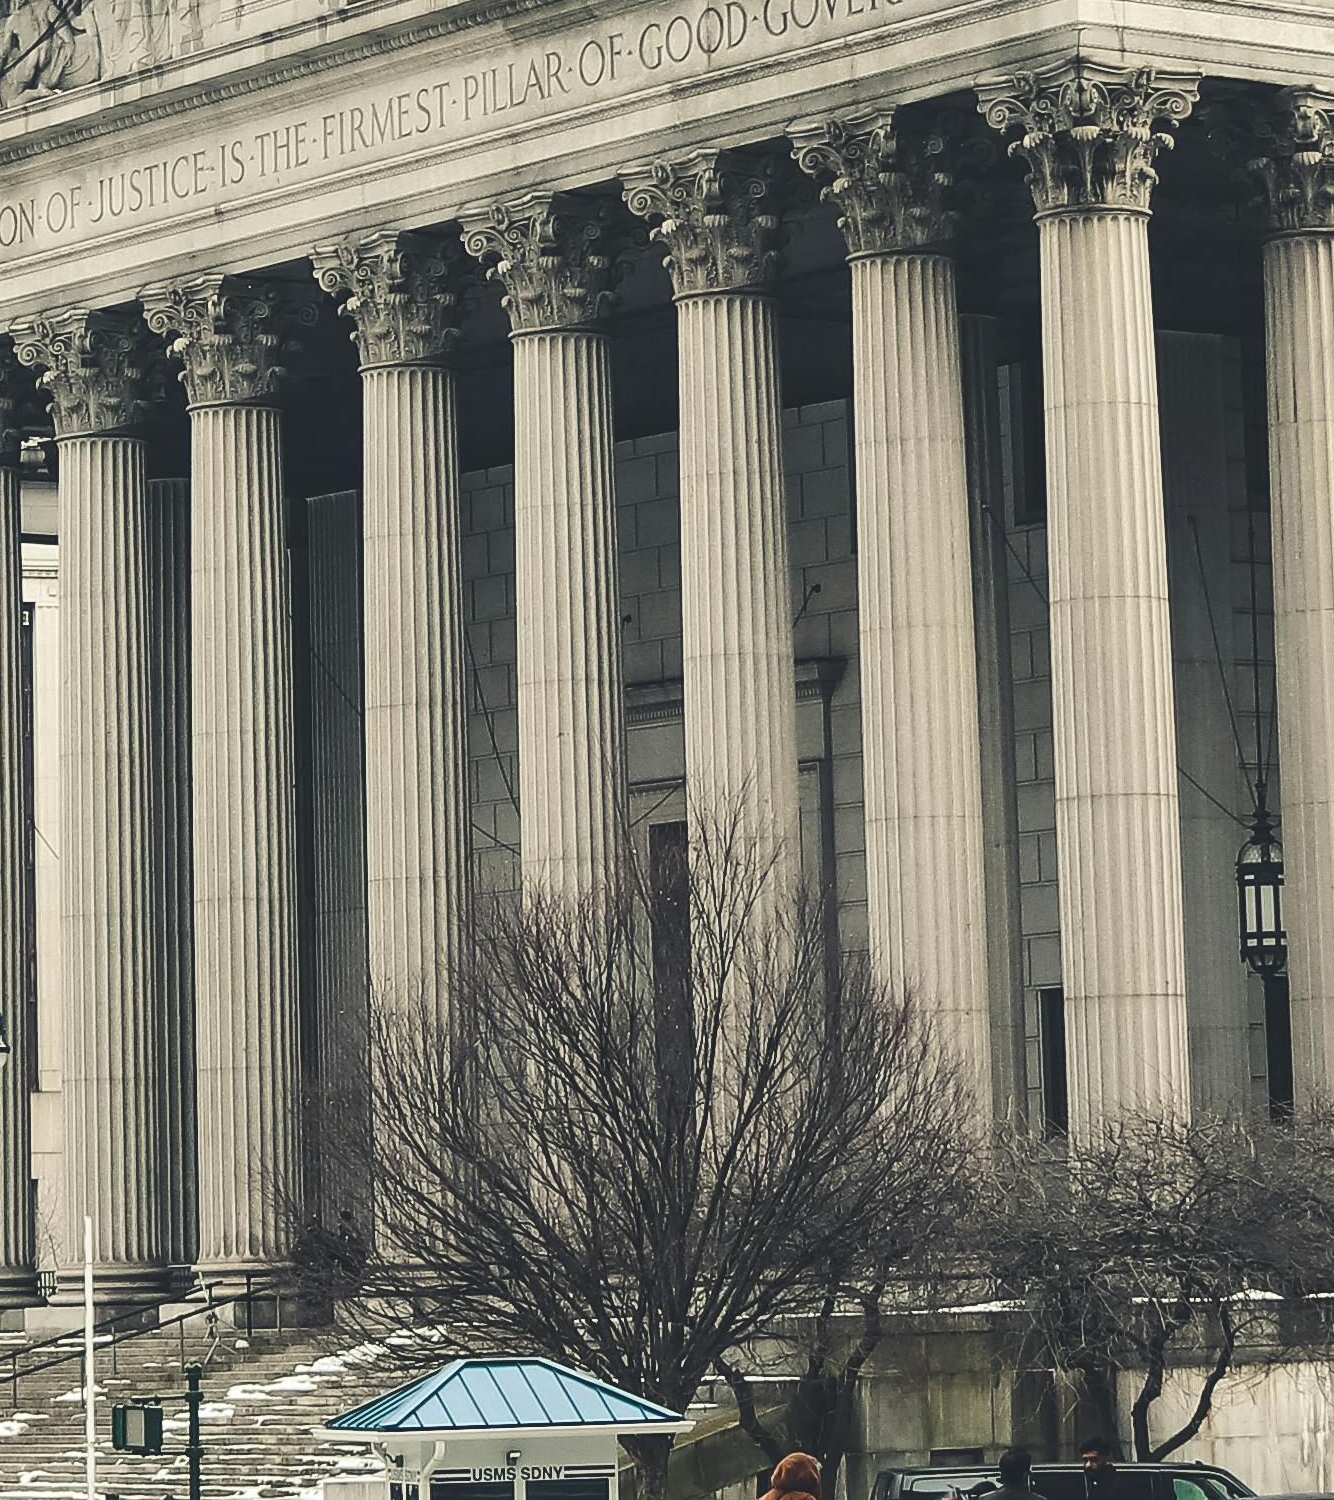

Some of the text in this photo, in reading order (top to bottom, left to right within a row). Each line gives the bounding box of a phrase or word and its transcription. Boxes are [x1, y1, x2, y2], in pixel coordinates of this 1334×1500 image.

[46, 186, 81, 234] OF
[89, 149, 208, 223] JUSTICE
[219, 140, 245, 188] IS
[254, 121, 309, 177] THE
[321, 81, 451, 160] FIRMEST
[463, 51, 571, 121] PILLAR
[578, 34, 625, 88] OF
[639, 1, 748, 70] GOOD
[472, 1465, 564, 1482] USMS SDNY
